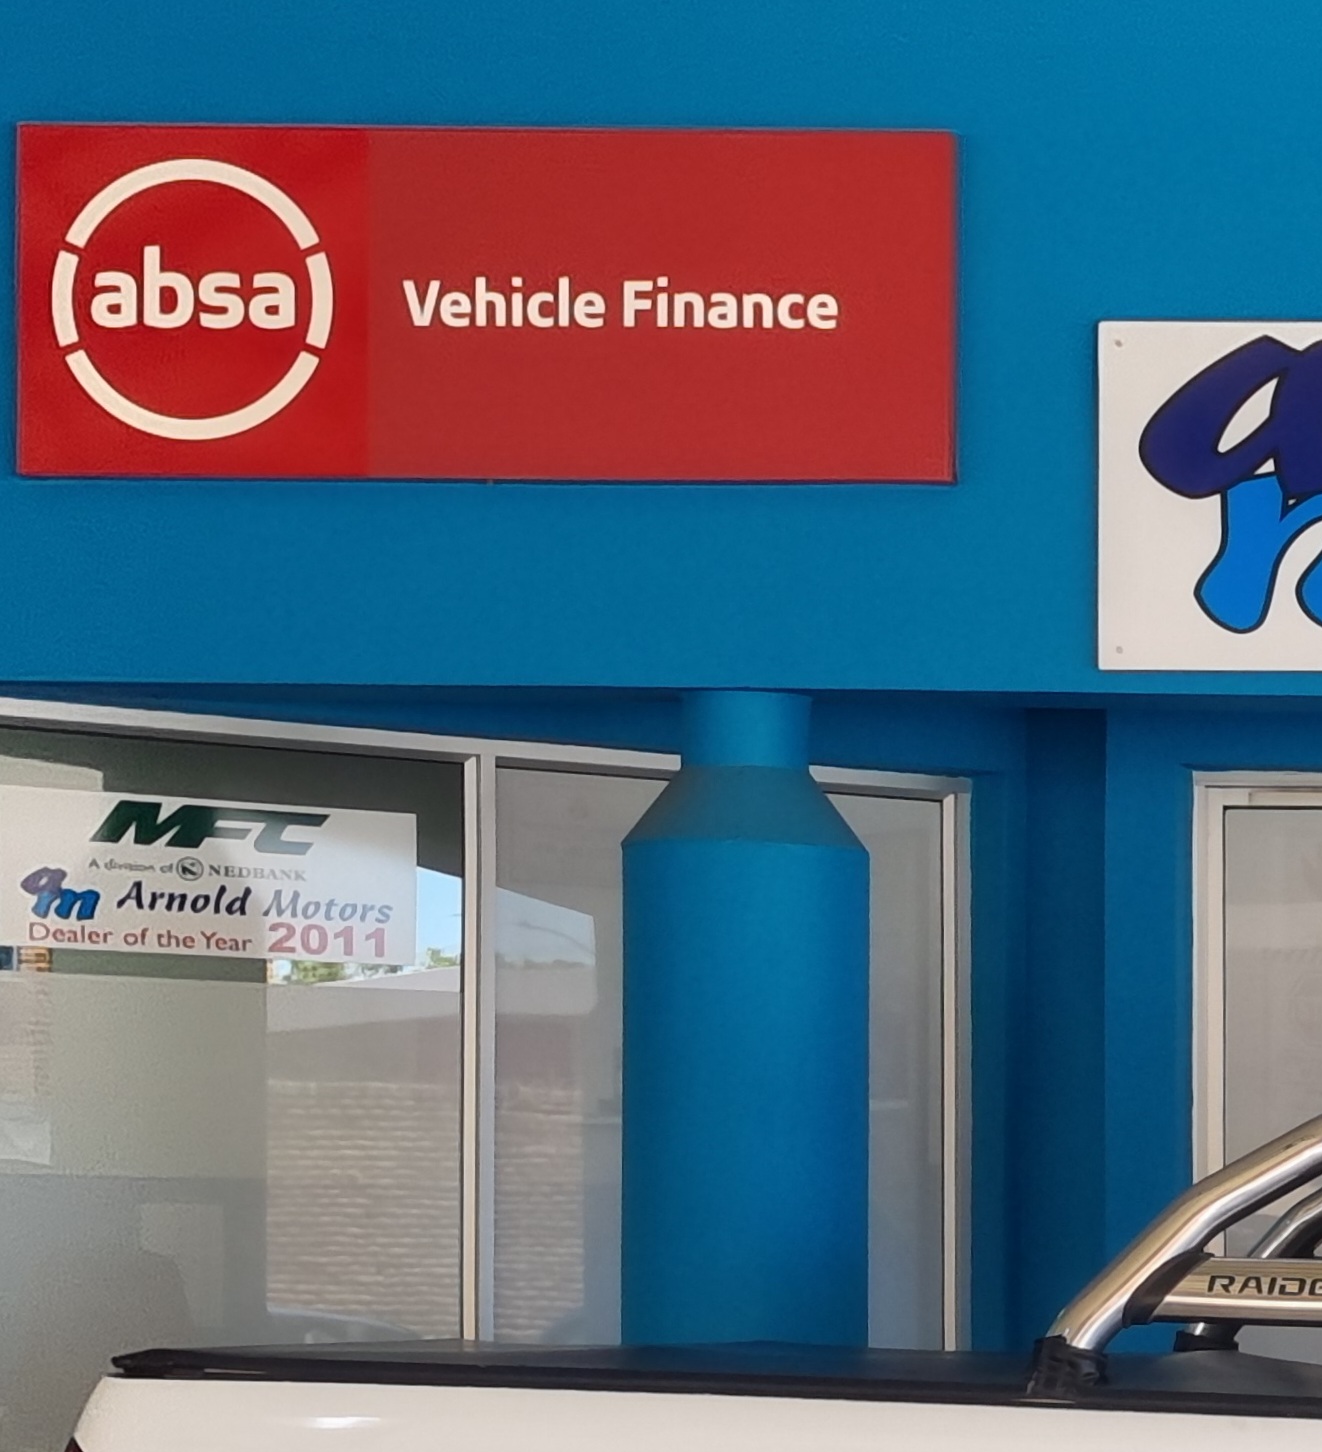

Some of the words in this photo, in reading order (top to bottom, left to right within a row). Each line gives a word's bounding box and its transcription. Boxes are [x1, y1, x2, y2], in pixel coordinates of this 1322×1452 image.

[90, 245, 297, 330] absa
[402, 278, 606, 328] Vehicle
[622, 279, 839, 329] Finance
[89, 800, 331, 856] MFC
[208, 863, 307, 882] NEDBANK
[116, 880, 253, 917] Arnold
[262, 887, 394, 925] Motors
[28, 921, 114, 946] Dealer
[123, 927, 150, 947] of
[157, 929, 196, 949] the
[200, 930, 253, 951] Year
[267, 921, 387, 958] 2011
